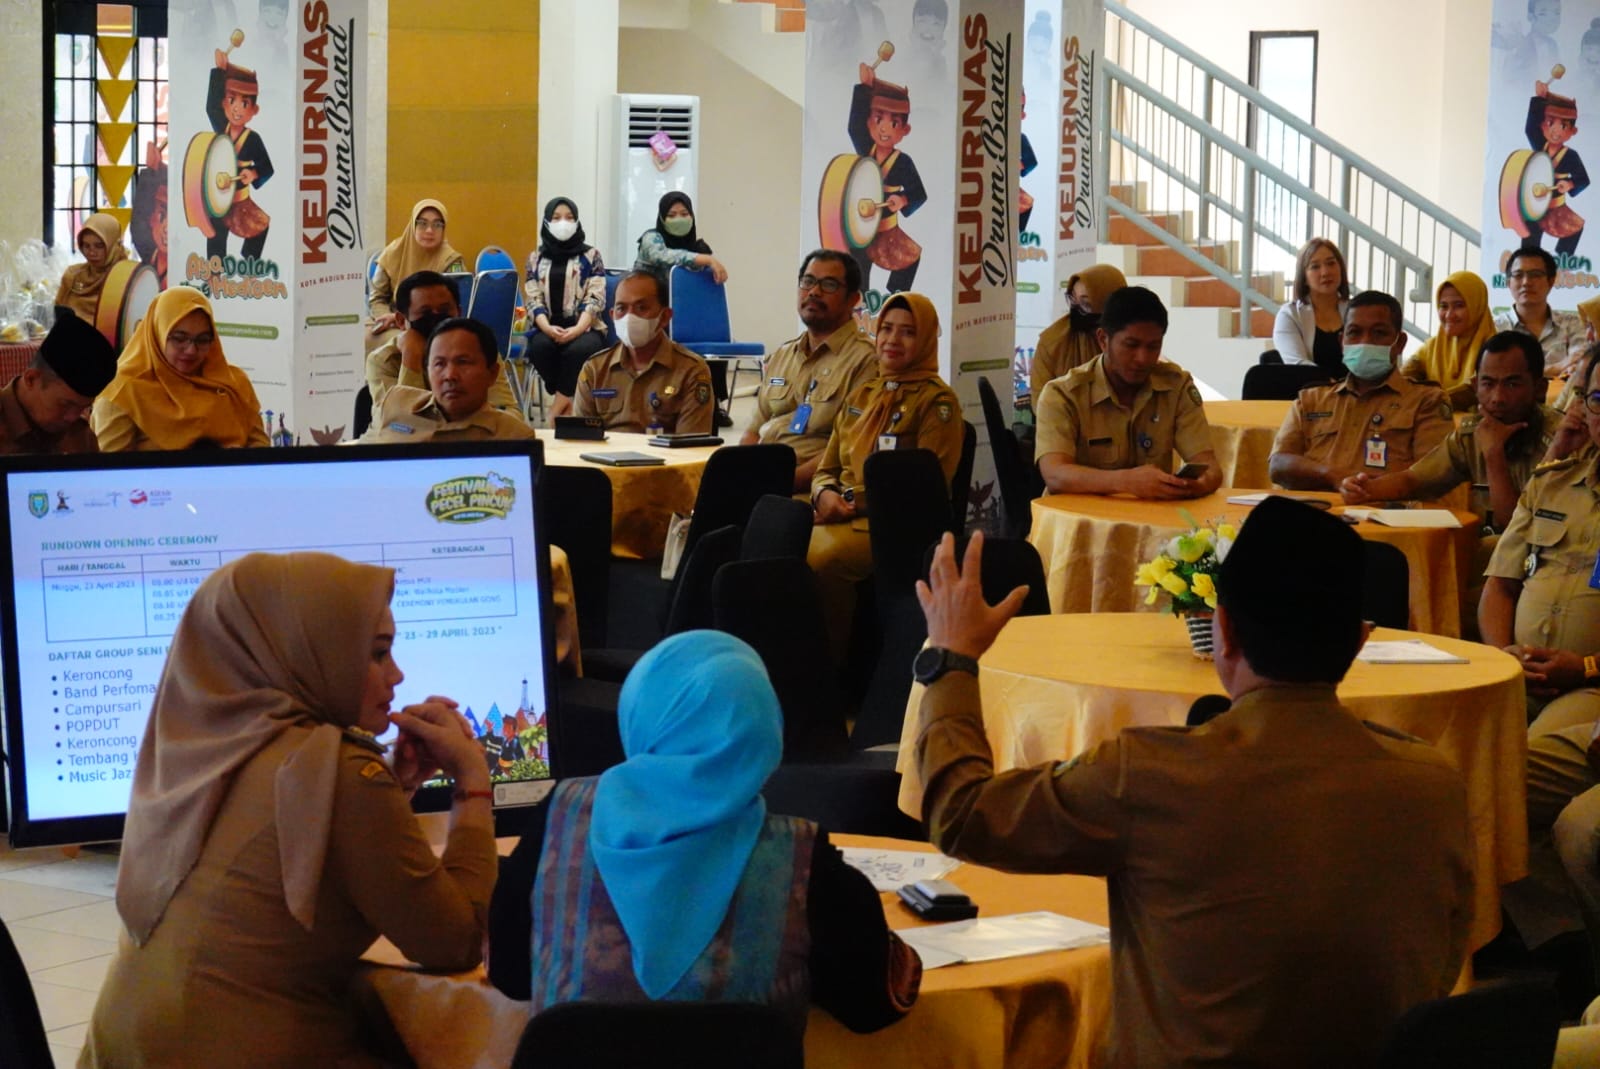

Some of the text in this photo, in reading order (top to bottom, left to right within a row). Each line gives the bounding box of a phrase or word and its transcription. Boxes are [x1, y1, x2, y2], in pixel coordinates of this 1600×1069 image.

[300, 0, 329, 264] KEJURNAS
[323, 23, 355, 250] Drum Band
[1059, 35, 1079, 241] KEJURNAS
[1075, 55, 1091, 230] Drum Band
[958, 12, 989, 305] KEJURNAS
[981, 39, 1007, 288] Drum Band
[223, 255, 279, 280] Dolan
[300, 279, 317, 288] KOTA
[319, 274, 345, 284] MADIUN
[41, 535, 219, 551] RUNDOWN OPENING CEREMONY
[432, 545, 485, 554] KETERANGAN
[57, 563, 79, 572] HARI
[86, 561, 126, 571] TANGGAL
[170, 559, 201, 567] WAKTU
[441, 627, 469, 638] APRIL
[472, 626, 496, 636] 2023
[49, 651, 92, 661] DAFTAR
[95, 648, 134, 659] GROUP
[137, 646, 162, 656] SENI
[63, 669, 133, 682] Keroncong
[64, 686, 98, 699] Band
[65, 701, 142, 716] Campursari
[66, 718, 121, 733] POPDUT
[67, 735, 137, 750] Keroncong
[68, 752, 129, 766] Tembang
[69, 768, 132, 783] Music Jaz
